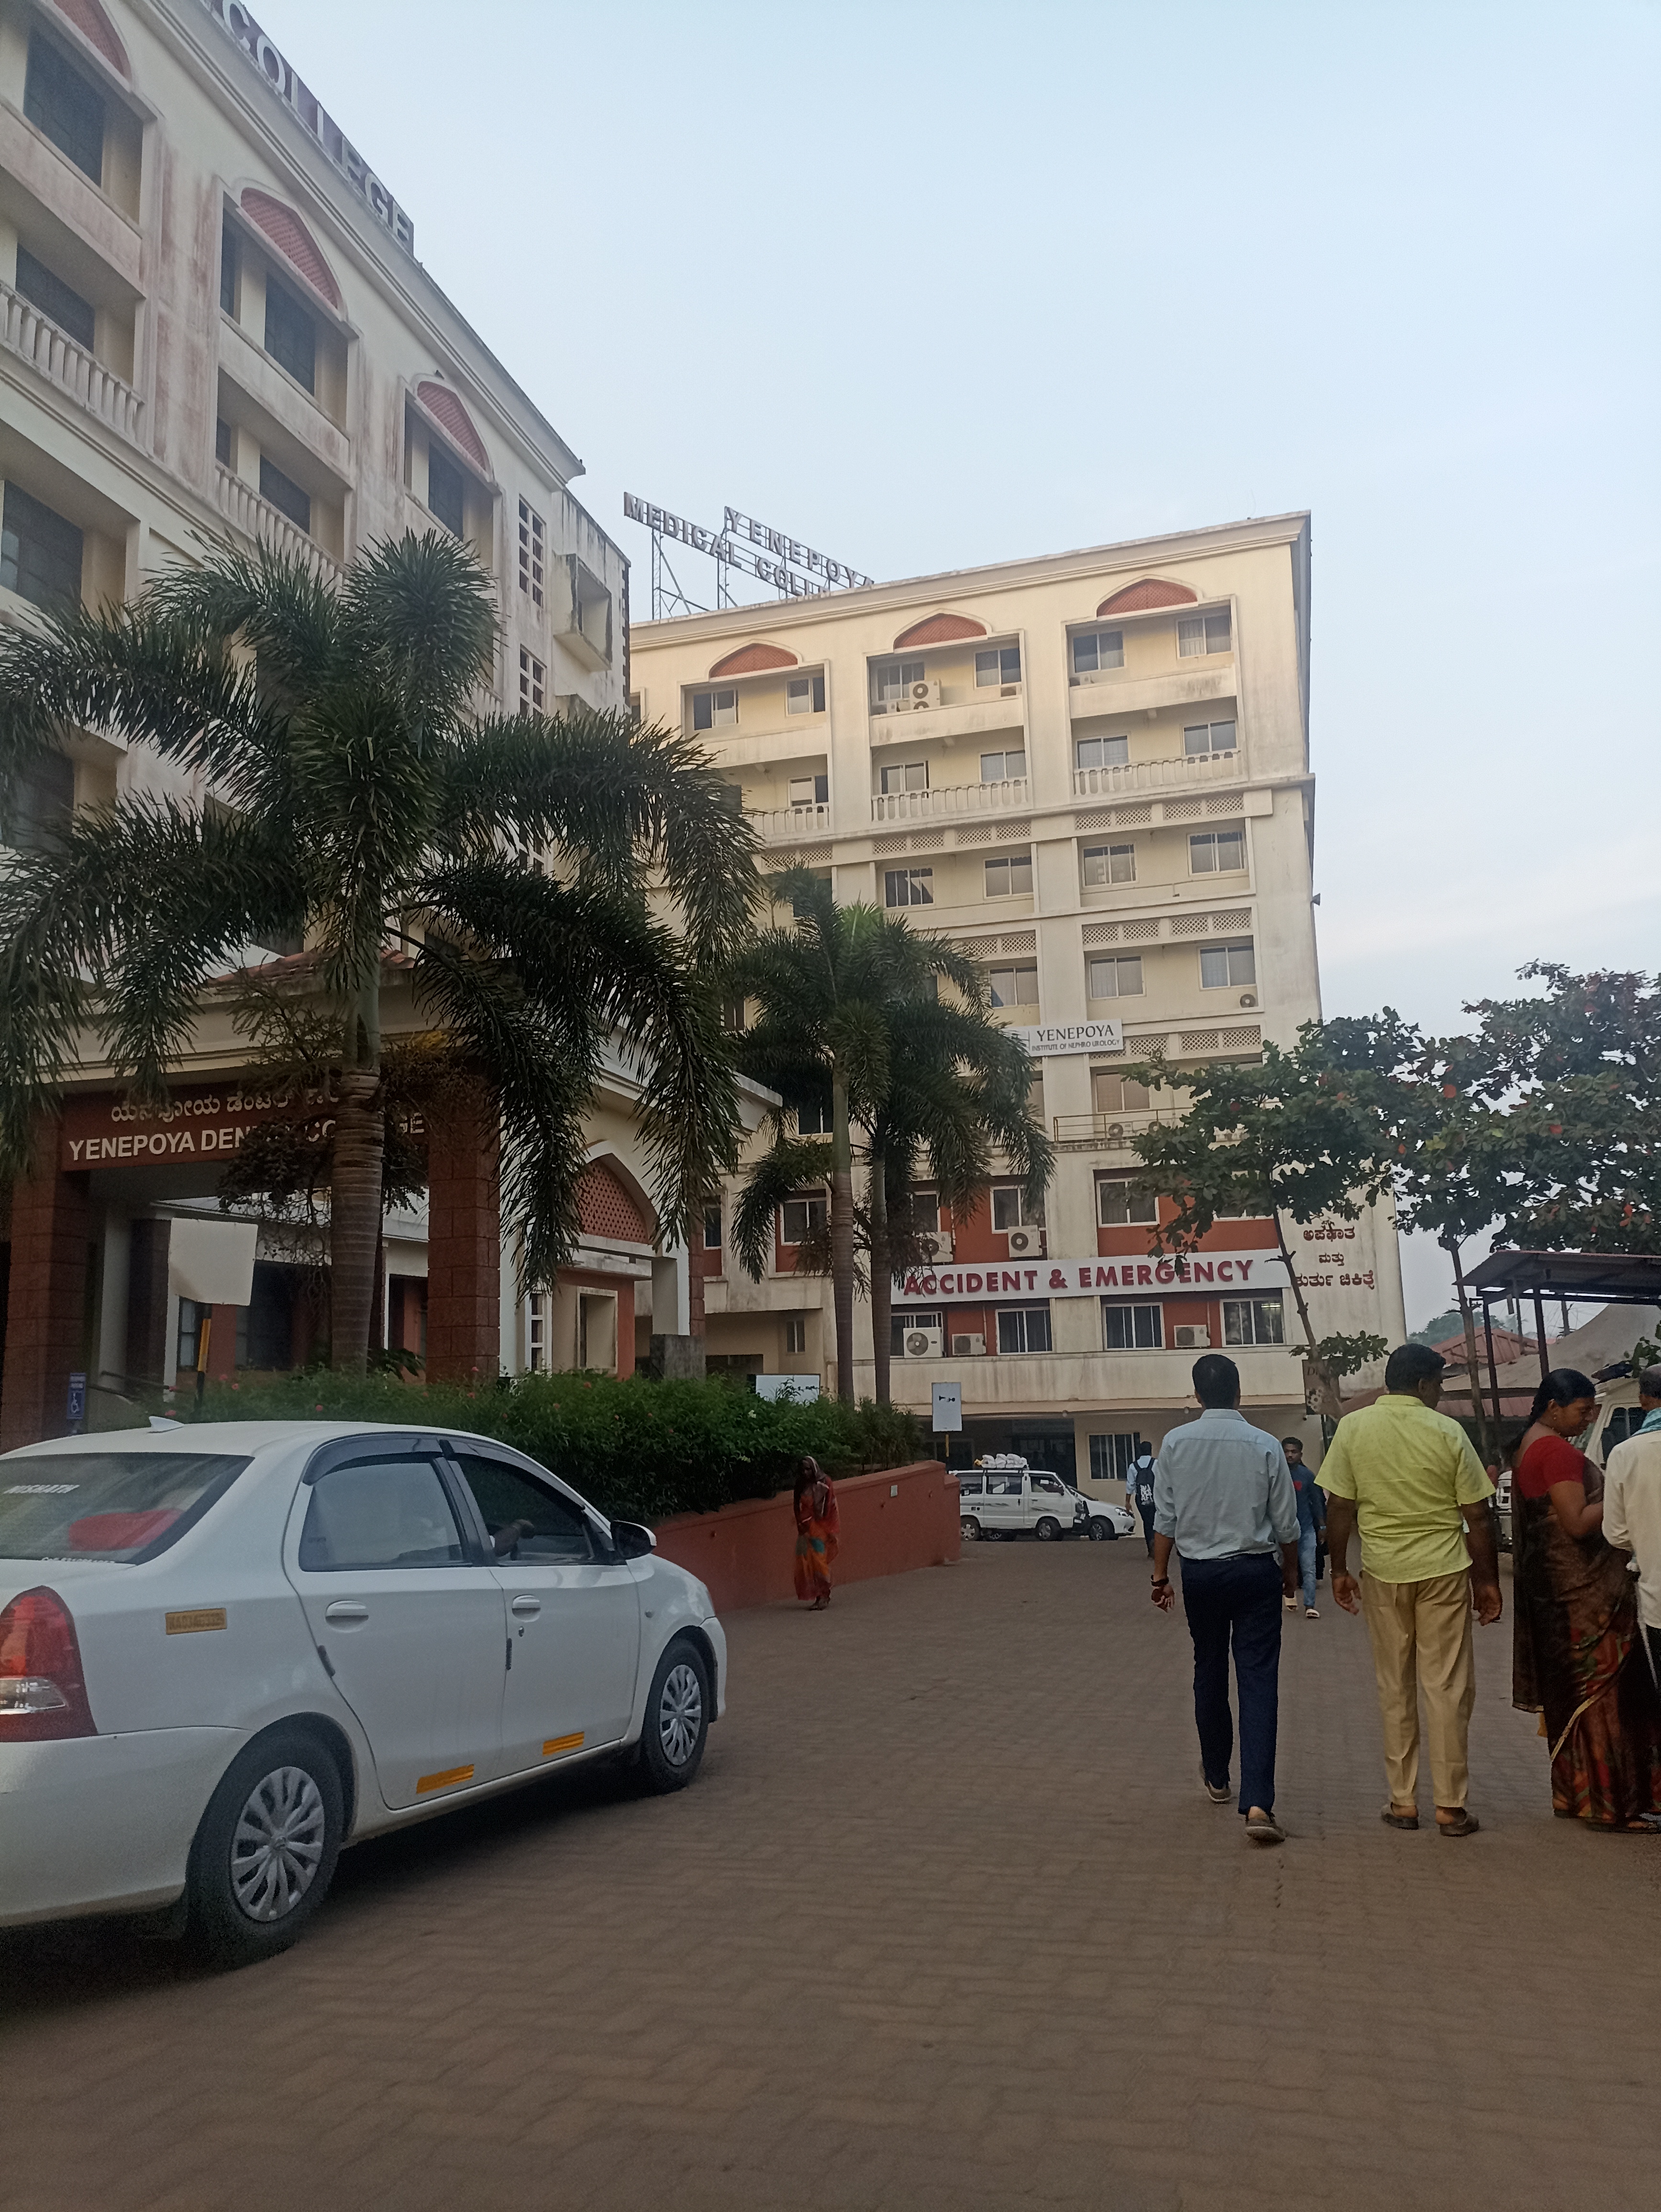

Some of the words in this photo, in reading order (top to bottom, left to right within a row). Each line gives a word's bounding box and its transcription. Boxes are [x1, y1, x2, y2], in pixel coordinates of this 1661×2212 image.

[624, 492, 742, 568] MEDICAL
[1037, 1025, 1114, 1041] YENEPOYA
[69, 1131, 195, 1161] YENEPOYA
[904, 1270, 1038, 1295] ACCIDENT
[1049, 1269, 1068, 1290] &
[1079, 1260, 1253, 1288] EMERGENCY
